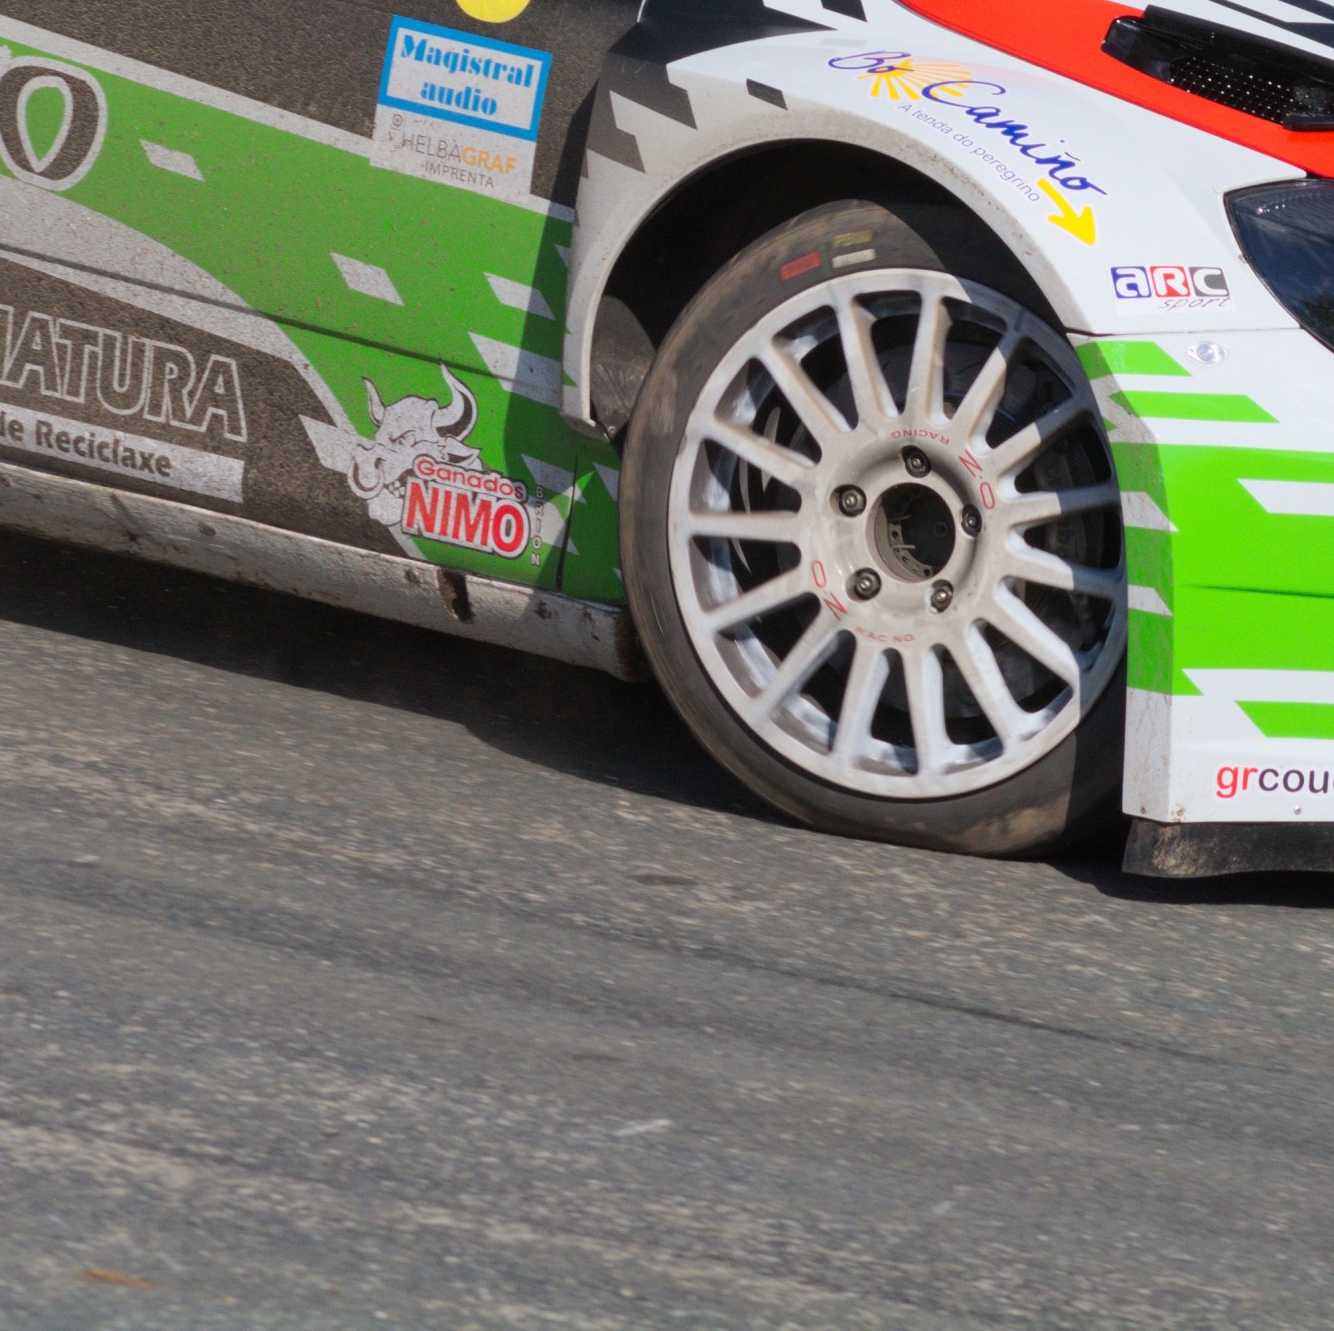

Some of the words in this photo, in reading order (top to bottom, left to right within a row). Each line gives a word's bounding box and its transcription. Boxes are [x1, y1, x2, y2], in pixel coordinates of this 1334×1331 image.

[400, 35, 534, 88] Magistral
[420, 82, 497, 115] audio
[401, 131, 517, 173] HELBAGRAF
[897, 102, 912, 113] A
[911, 107, 952, 135] tenda
[953, 133, 974, 149] do
[969, 146, 1041, 203] peregrino
[425, 161, 494, 188] IMPRENTA
[1159, 295, 1233, 310] sport
[36, 421, 172, 479] Reciclaxe
[890, 429, 951, 445] RACING
[417, 459, 524, 499] Ganados
[406, 482, 524, 553] NIMO
[855, 625, 915, 642] RACNG
